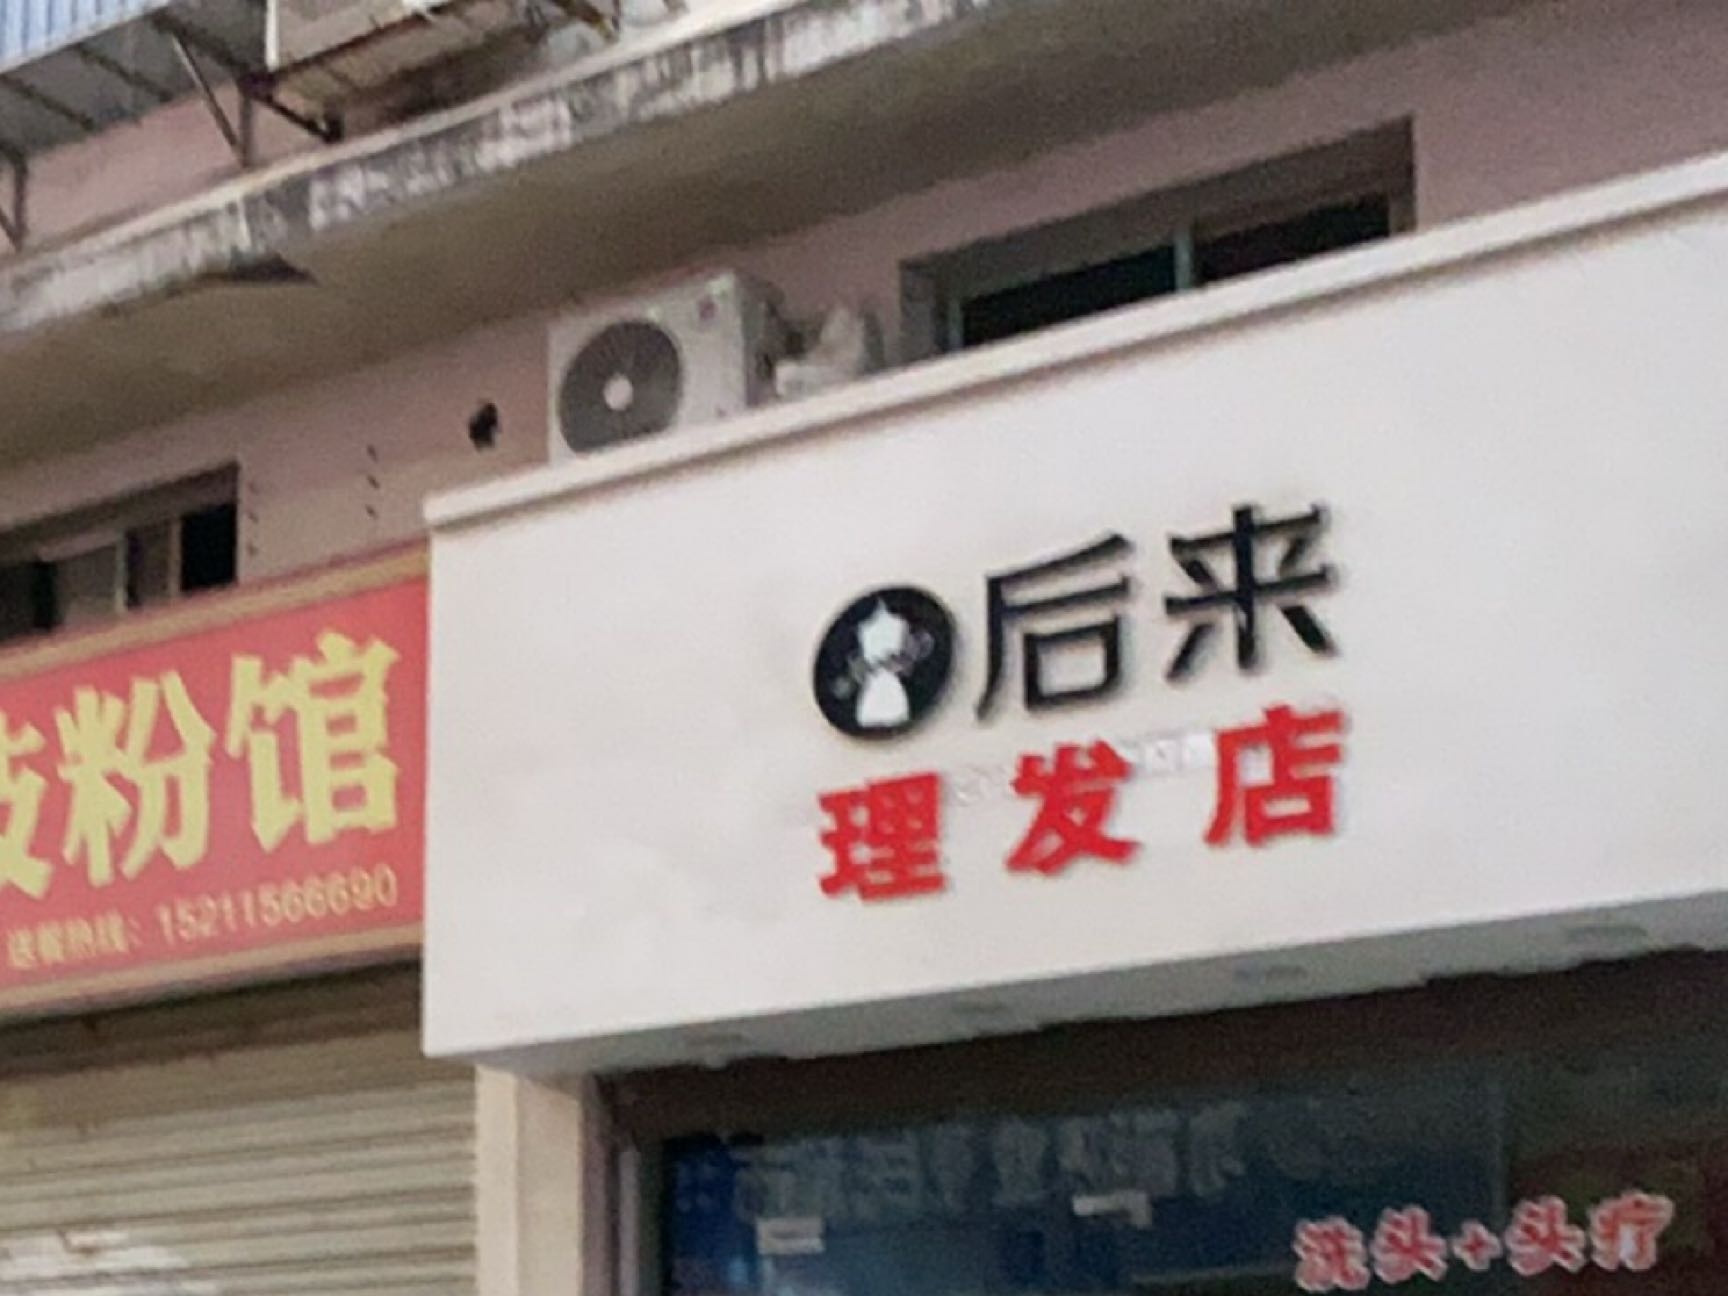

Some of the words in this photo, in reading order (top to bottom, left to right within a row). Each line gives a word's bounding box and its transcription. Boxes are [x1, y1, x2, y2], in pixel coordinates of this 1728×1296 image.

[977, 503, 1341, 722] 后来
[817, 702, 1345, 902] 理发店
